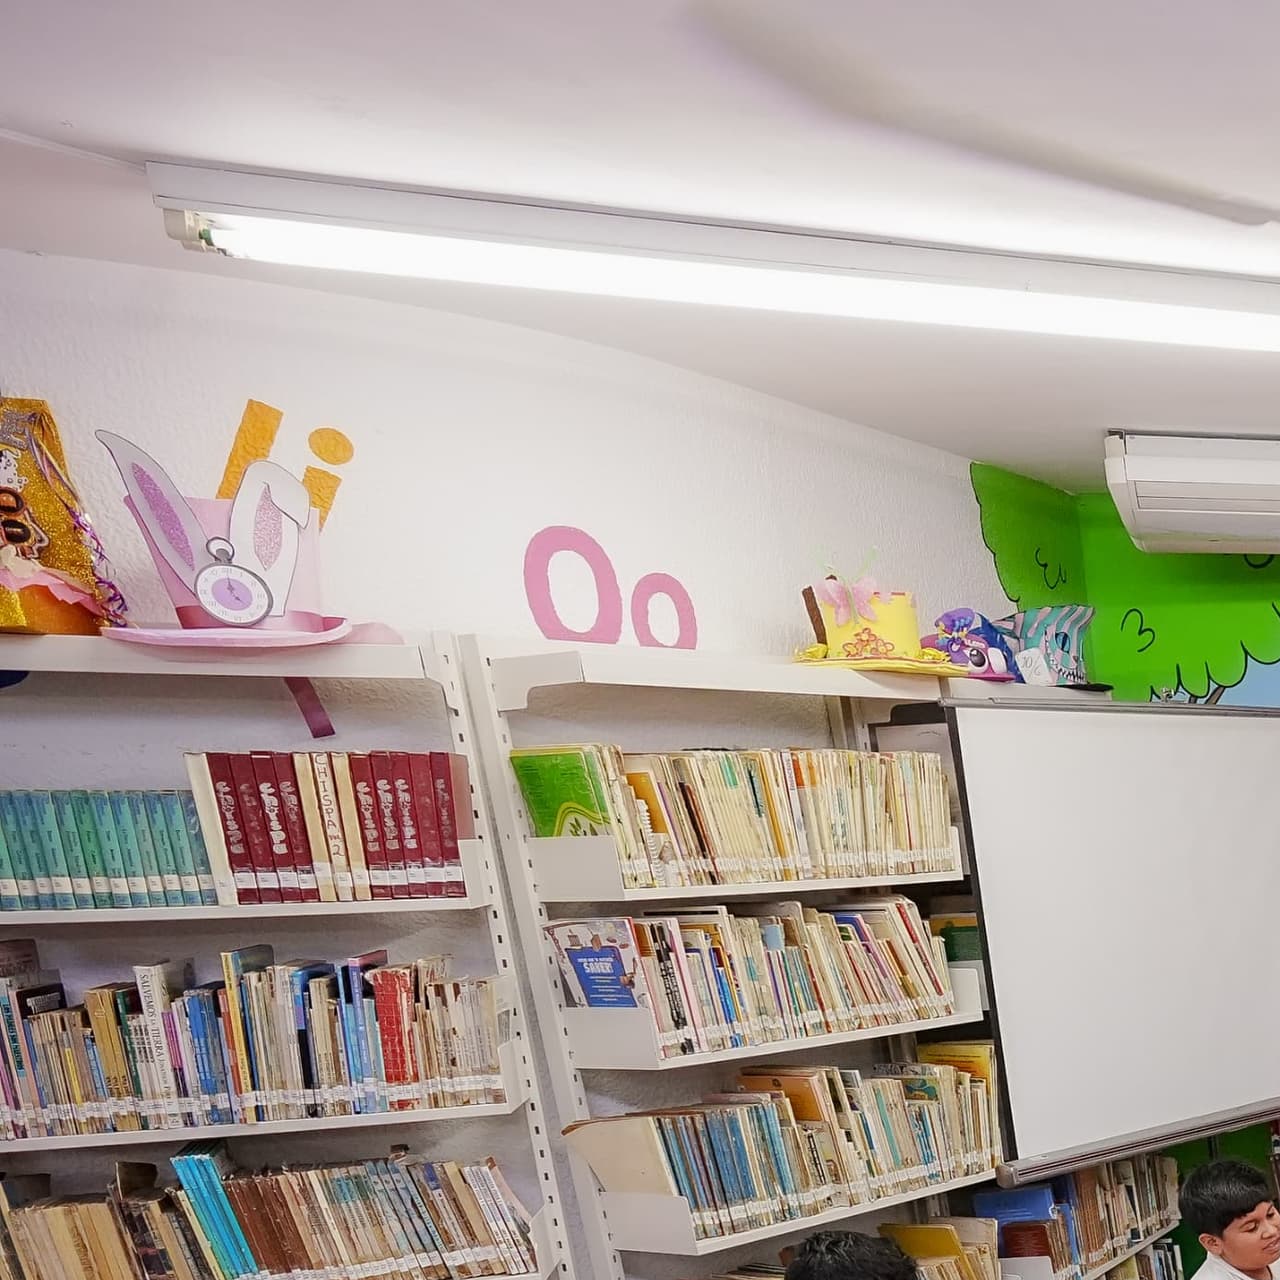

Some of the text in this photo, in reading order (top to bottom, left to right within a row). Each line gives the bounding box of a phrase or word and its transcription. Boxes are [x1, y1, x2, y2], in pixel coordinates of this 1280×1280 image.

[315, 753, 337, 829] CHISPA
[140, 974, 157, 1020] SALVEMOS
[151, 1027, 165, 1060] TIERRA
